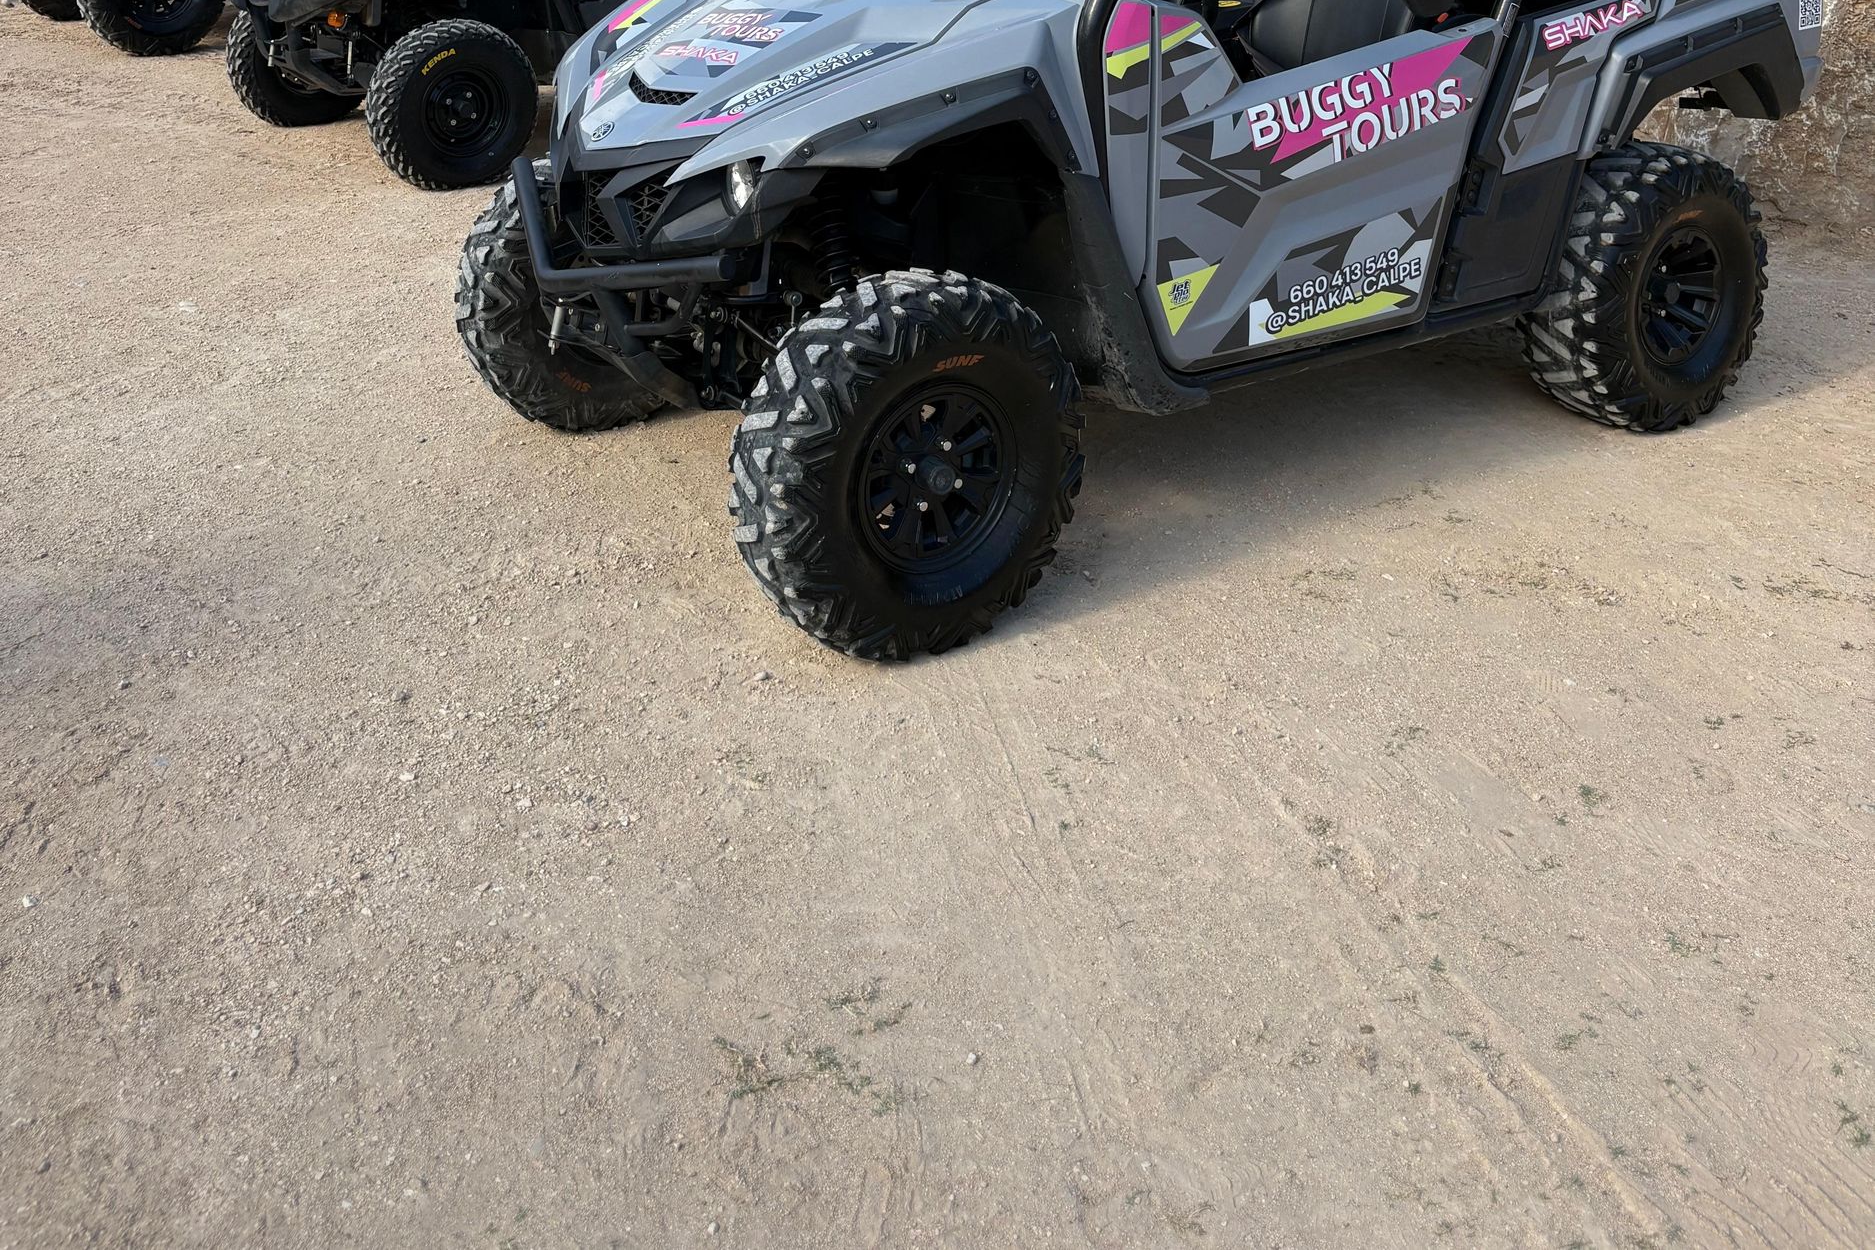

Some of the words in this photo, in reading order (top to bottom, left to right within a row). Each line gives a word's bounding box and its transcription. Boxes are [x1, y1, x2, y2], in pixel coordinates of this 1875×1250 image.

[700, 12, 772, 25] BUGGY
[710, 24, 784, 41] TOURS
[1543, 0, 1643, 49] SHAKA
[421, 48, 456, 75] KENDA
[659, 45, 739, 64] SHAKA
[744, 78, 782, 99] 660
[784, 65, 814, 82] 413
[816, 51, 850, 69] 549
[1247, 62, 1394, 148] BUGGY
[1289, 274, 1328, 303] 660
[1331, 265, 1362, 288] 413
[1365, 248, 1399, 275] 549
[1266, 258, 1421, 333] @SHAKA_CALPE
[932, 354, 985, 372] SUNF
